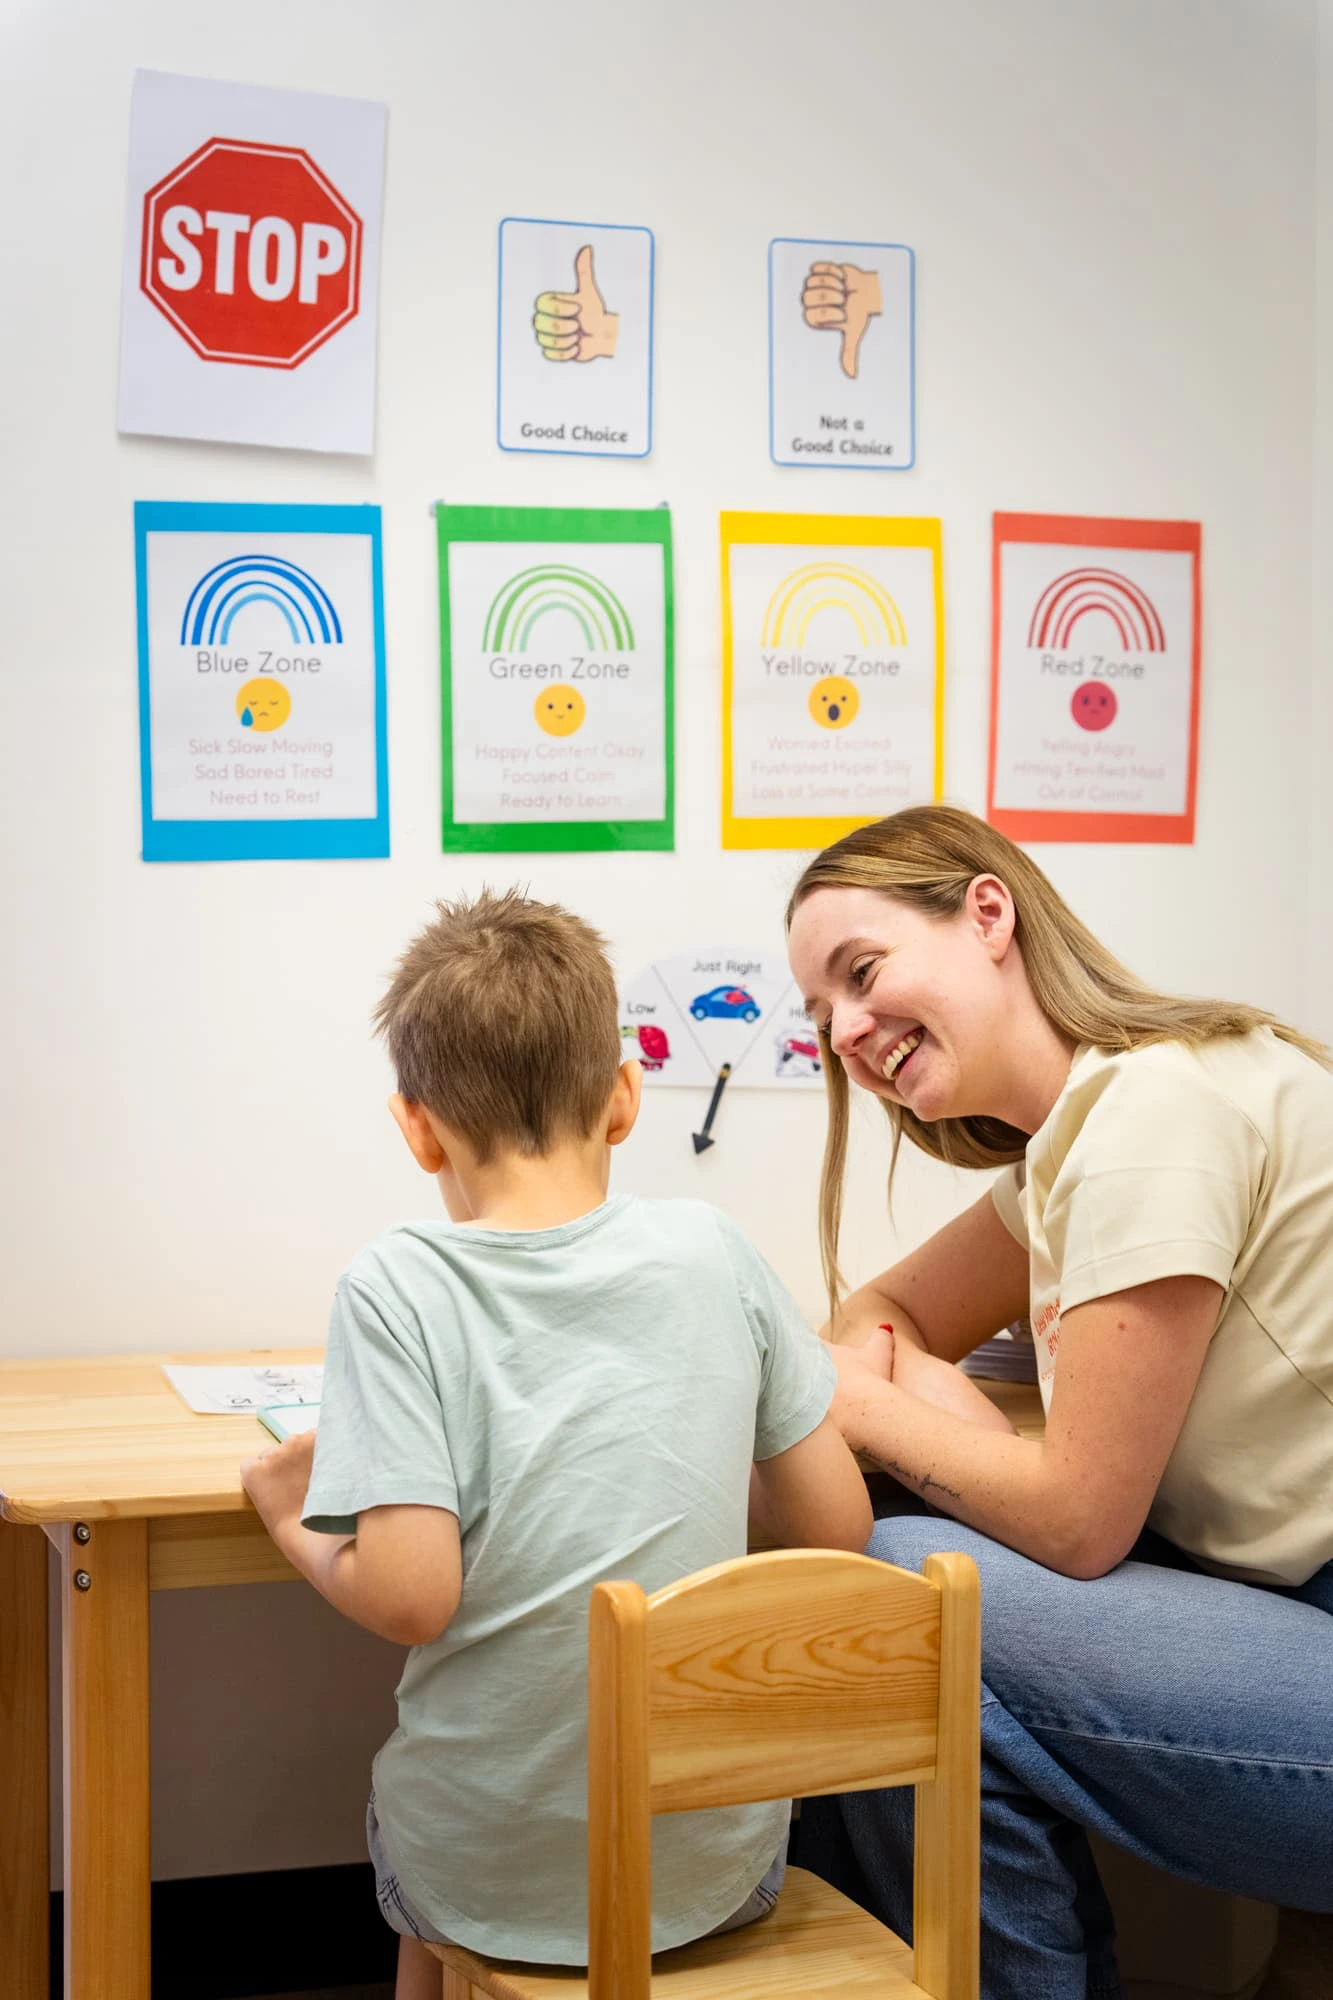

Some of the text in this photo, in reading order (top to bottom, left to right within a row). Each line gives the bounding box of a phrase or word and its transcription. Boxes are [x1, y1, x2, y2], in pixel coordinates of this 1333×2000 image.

[157, 204, 347, 305] STOP
[520, 422, 629, 443] Good Choice
[819, 414, 865, 432] Not a
[791, 437, 893, 456] Good Choice
[196, 650, 322, 674] Blue Zone
[488, 656, 631, 680] Green Zone
[761, 655, 901, 677] Yellow Zone
[1040, 654, 1146, 679] Red Zone
[188, 738, 334, 758] Sick Slow Moving
[474, 742, 645, 763] Happy Content Okay
[194, 762, 334, 781] Sad Bored Tired
[501, 768, 617, 784] Focused Calm
[209, 788, 321, 806] Need to Rest
[500, 791, 622, 812] Ready to Learn
[691, 958, 762, 976] Just Right
[626, 1001, 656, 1015] Low
[789, 1007, 811, 1021] Hi
